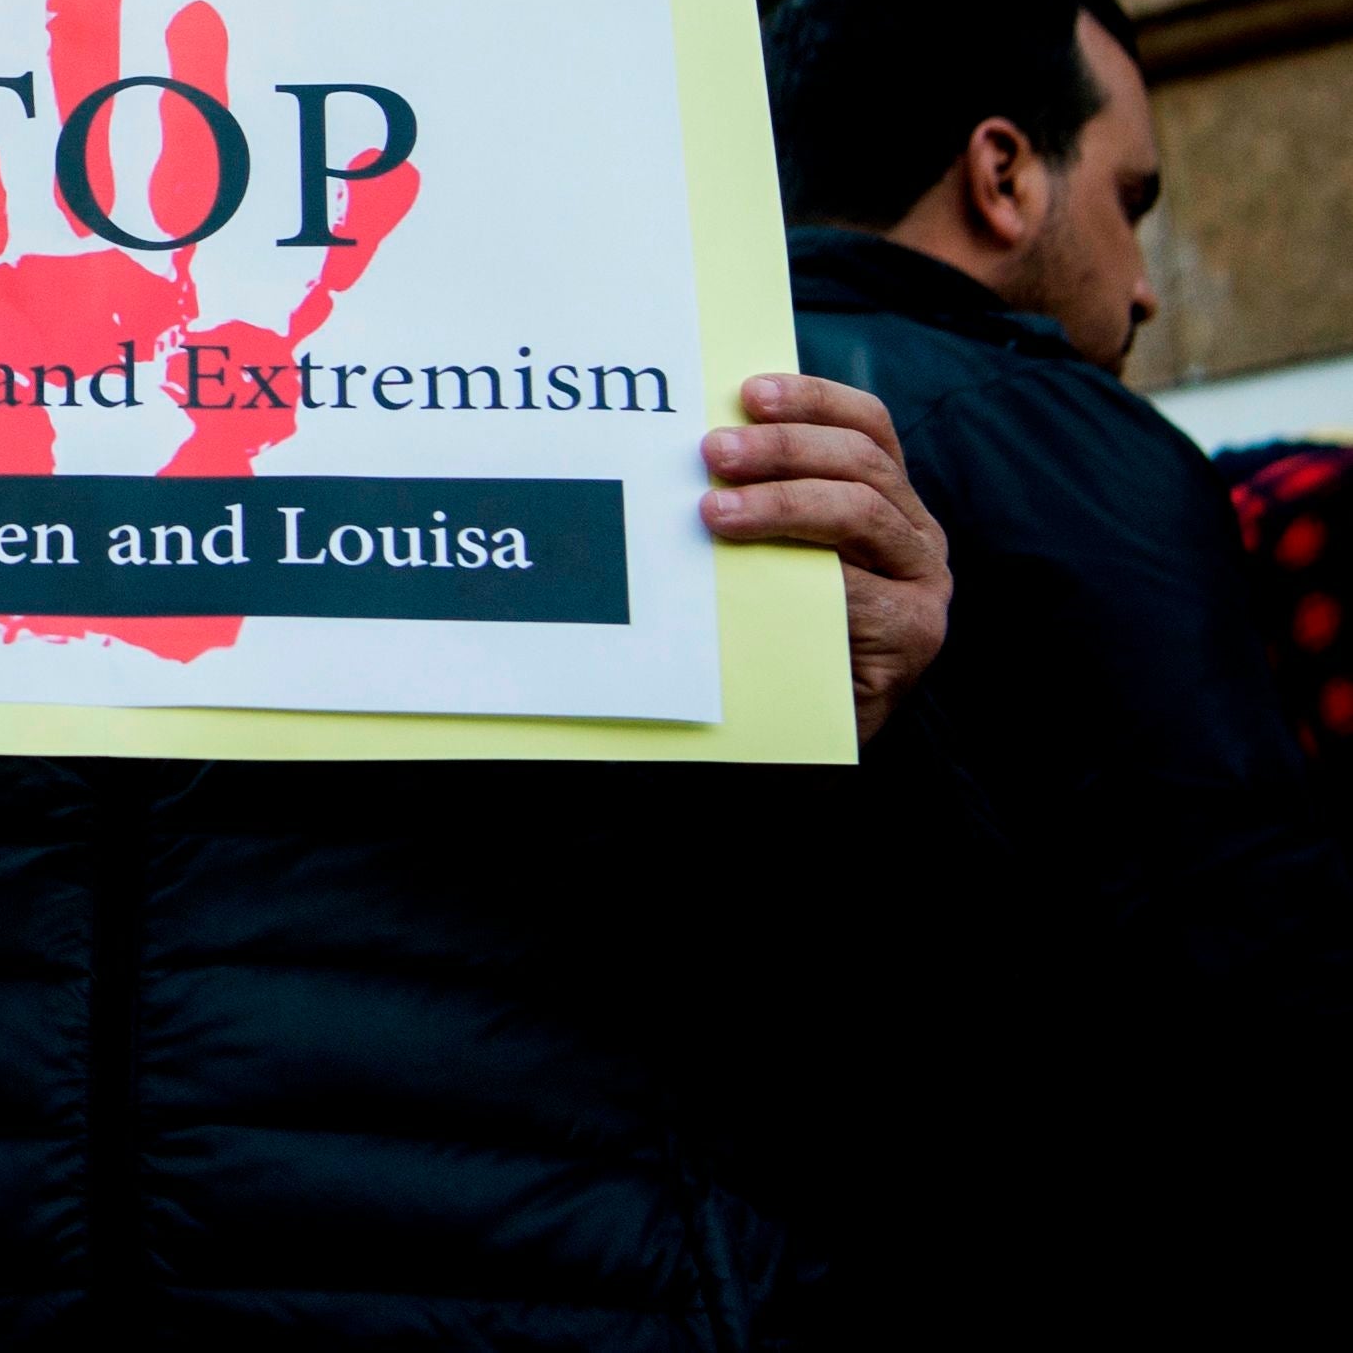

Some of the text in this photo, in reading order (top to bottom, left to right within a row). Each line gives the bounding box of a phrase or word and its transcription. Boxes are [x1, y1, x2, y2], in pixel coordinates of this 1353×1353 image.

[178, 345, 677, 413] Extremism
[108, 503, 248, 565] and
[277, 507, 533, 569] Louisa
